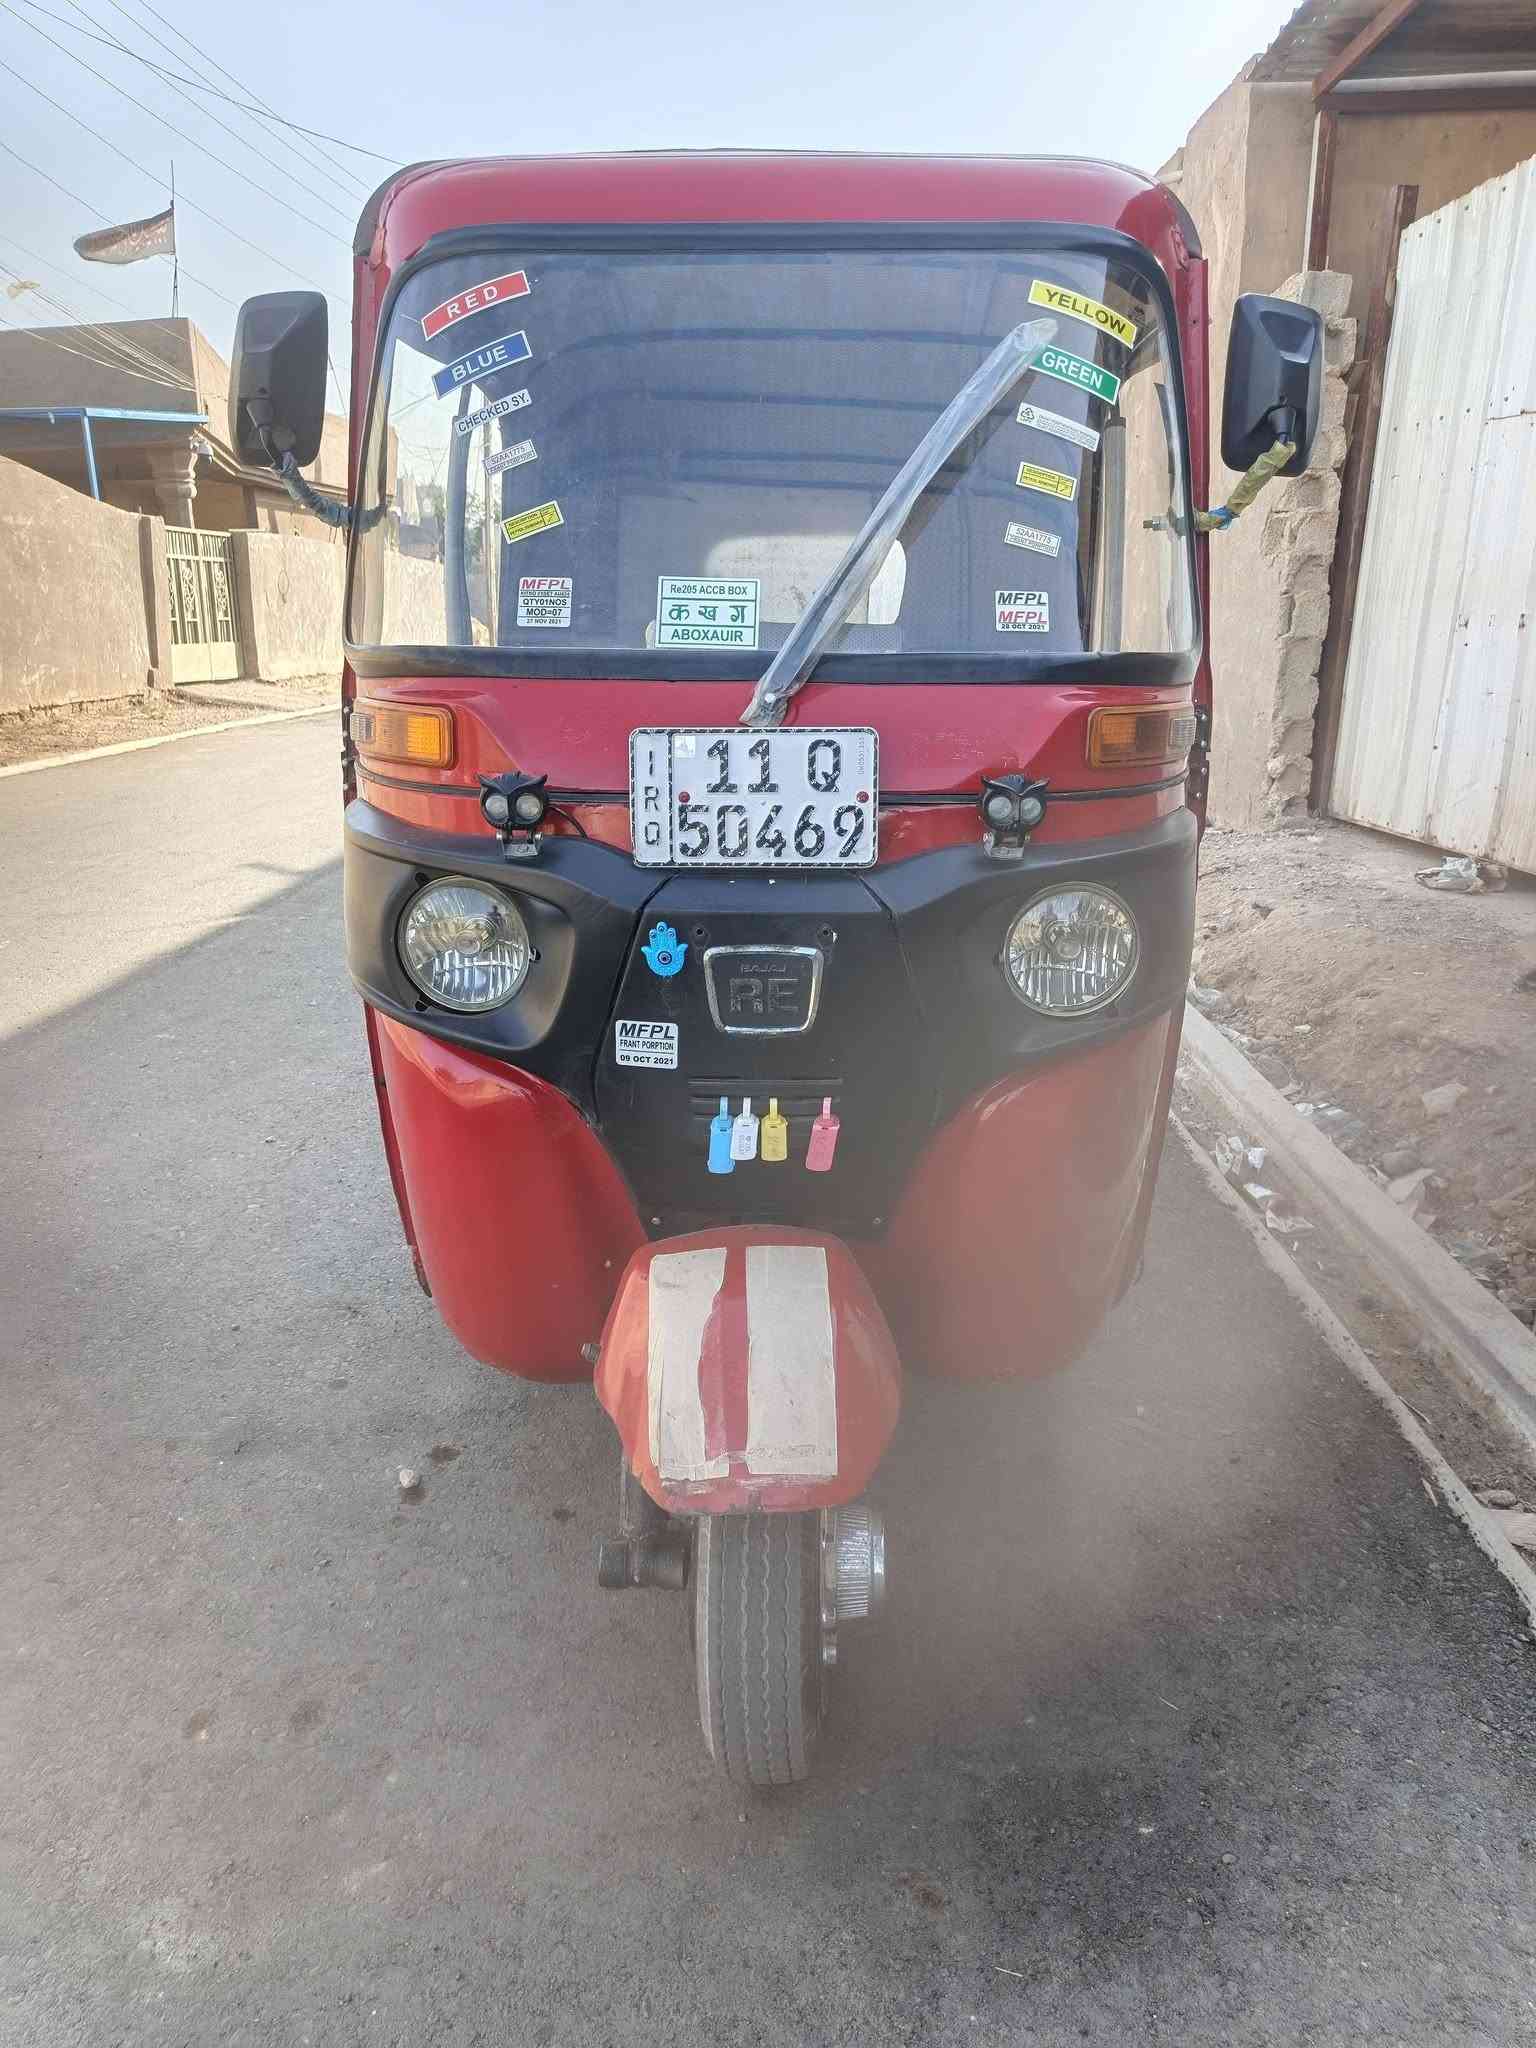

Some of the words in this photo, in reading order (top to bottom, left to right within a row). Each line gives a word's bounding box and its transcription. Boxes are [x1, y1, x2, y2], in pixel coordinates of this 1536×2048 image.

[446, 286, 498, 319] RED
[1045, 288, 1126, 334] YELLOW
[451, 344, 509, 382] BLUE
[1041, 352, 1104, 389] GREEN
[458, 401, 510, 433] CHECKED
[522, 579, 570, 589] MFPL
[670, 584, 697, 594] Re205
[699, 585, 726, 595] ACCB
[728, 586, 748, 595] BOX
[522, 598, 567, 606] QTY01NOS
[998, 592, 1047, 604] MFPL
[527, 608, 562, 616] MOD=07
[668, 604, 690, 621] क
[698, 605, 719, 621] ख
[729, 605, 749, 623] ग
[999, 611, 1048, 622] MFPL
[671, 629, 744, 642] ABOXAUIR
[706, 739, 779, 793] 11
[807, 738, 842, 793] Q
[678, 804, 864, 858] 50469
[728, 977, 801, 1013] RE
[619, 1023, 675, 1039] MFPL
[620, 1039, 640, 1049] FRANT
[654, 1057, 673, 1065] 2021
